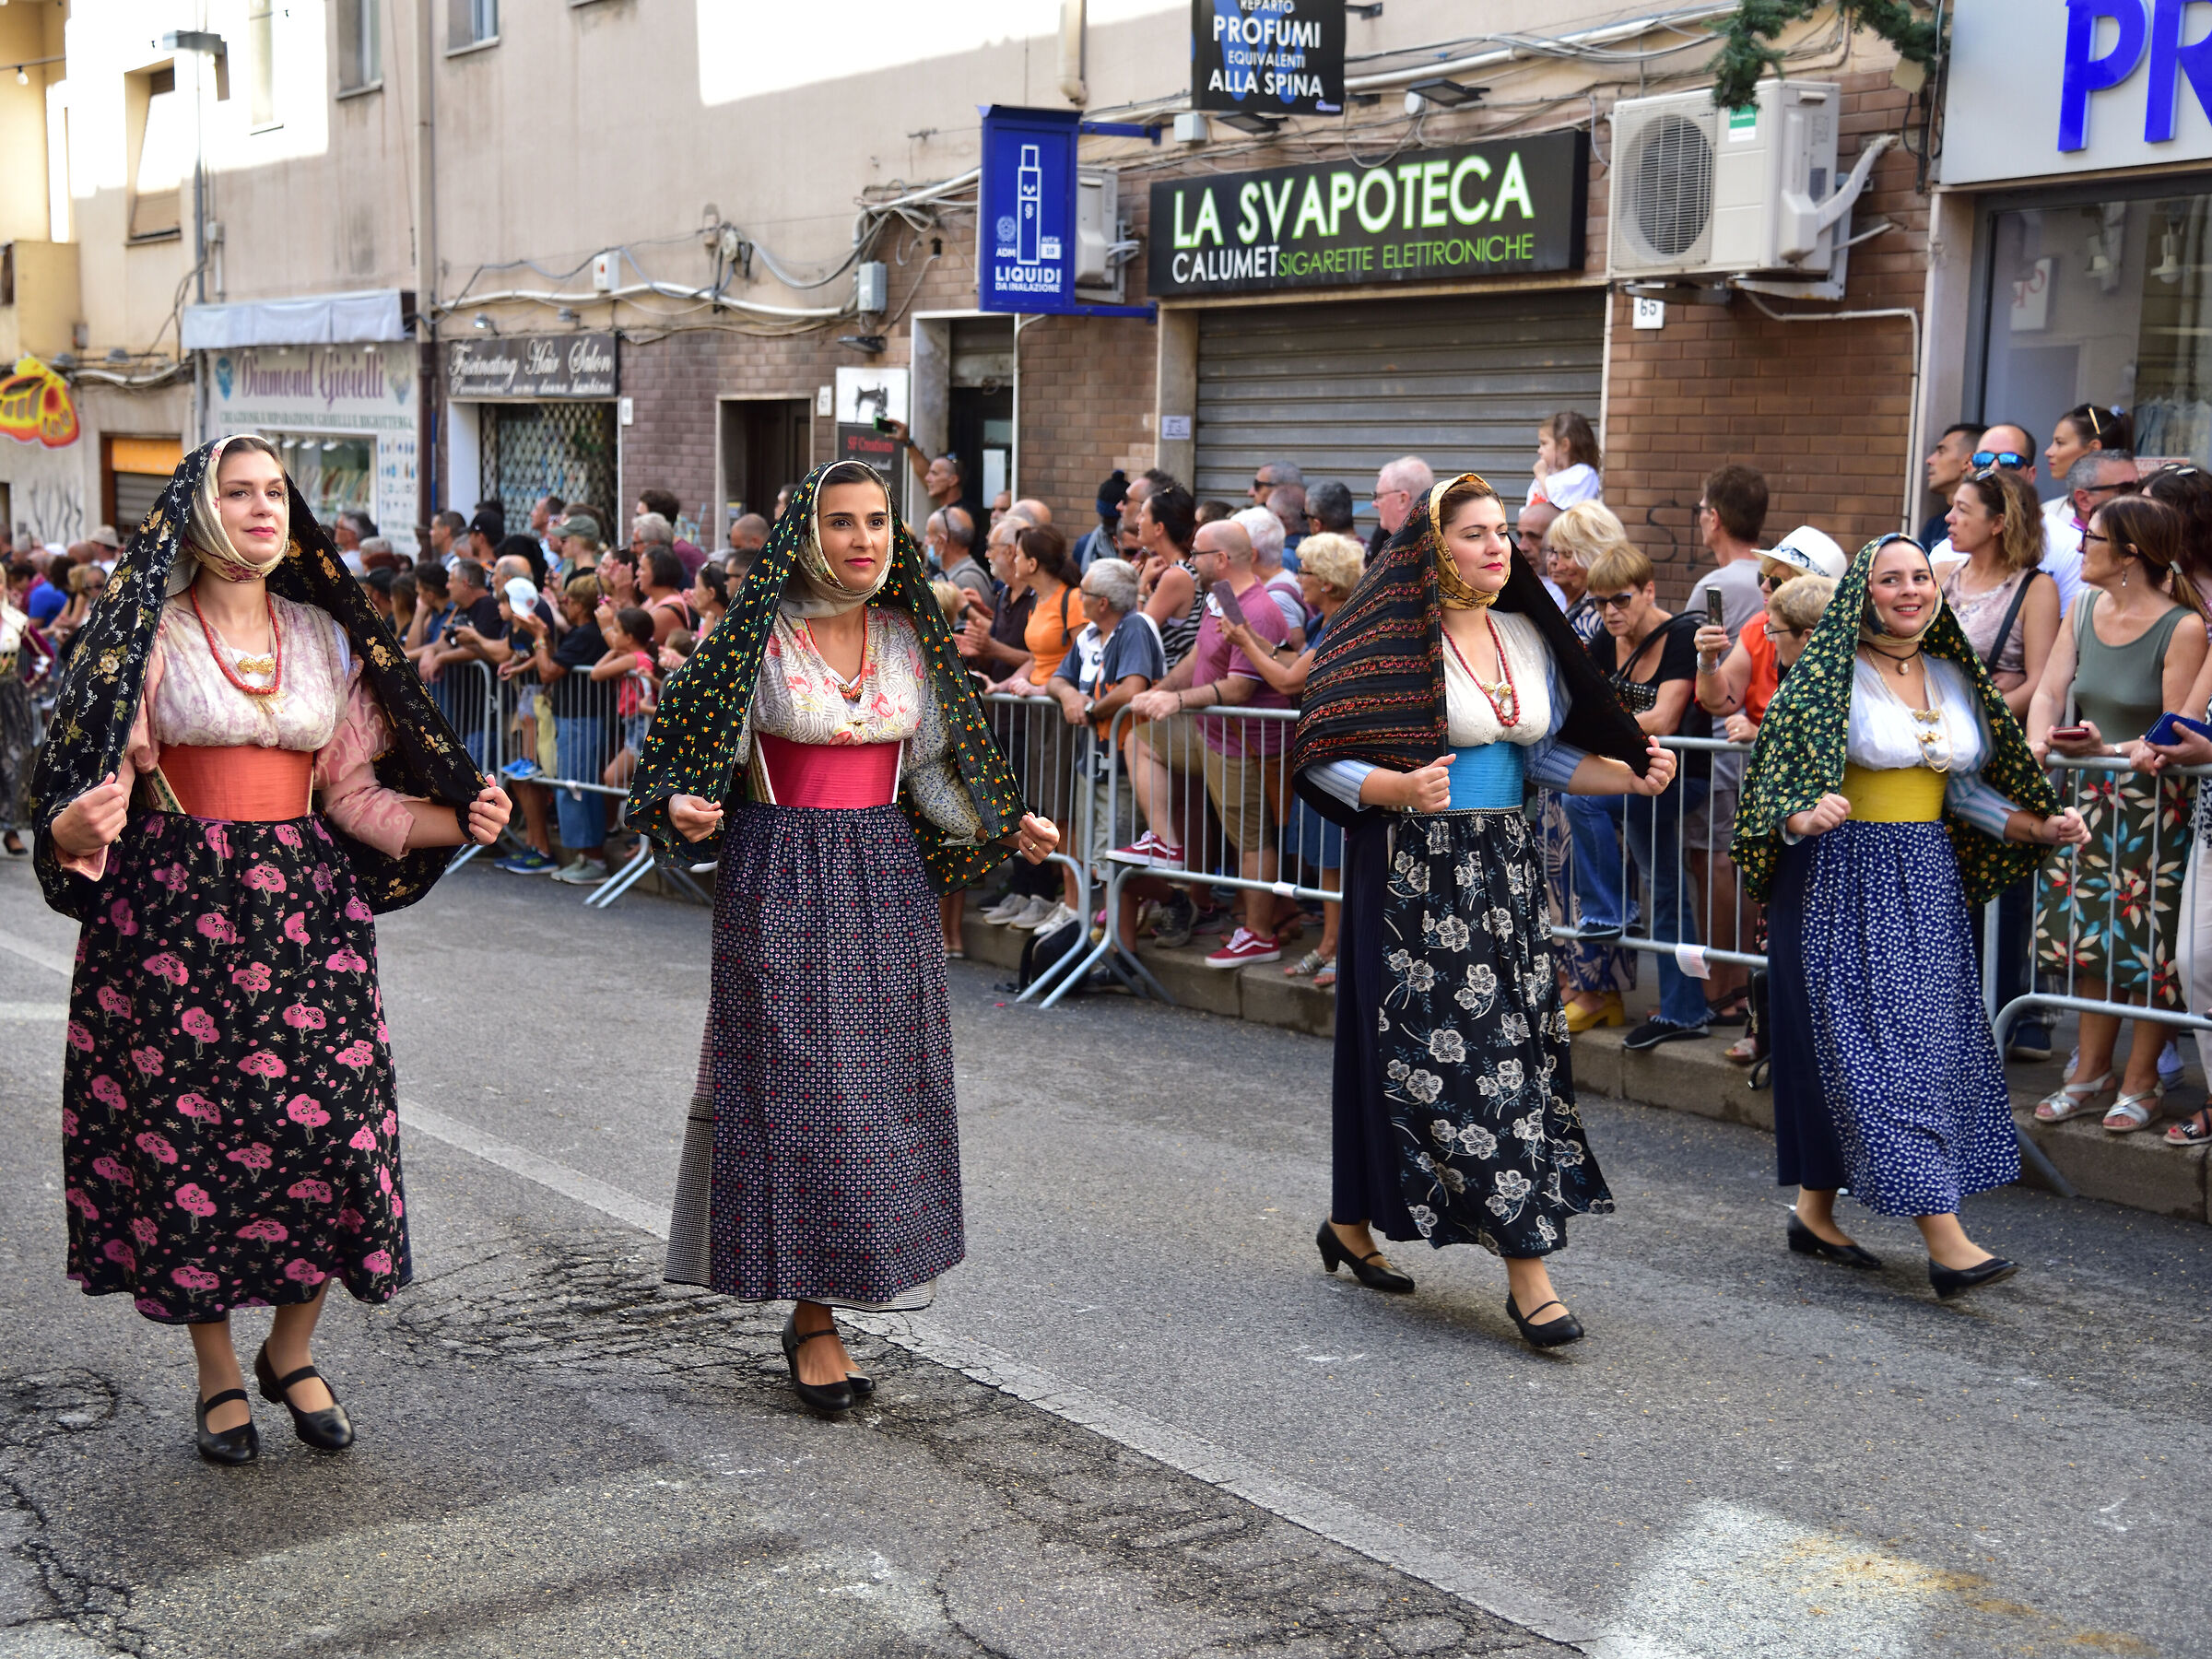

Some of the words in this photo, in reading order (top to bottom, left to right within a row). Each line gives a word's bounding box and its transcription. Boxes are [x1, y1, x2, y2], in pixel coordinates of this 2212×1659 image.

[1240, 0, 1295, 14] REPARTO
[1213, 15, 1321, 49] PROFUMI
[1228, 50, 1306, 68] EQUIVALENTI
[1208, 68, 1259, 94] ALLA
[1264, 71, 1324, 98] SPINA
[1173, 187, 1224, 250] LA
[1236, 151, 1535, 245] SVAPOTECA
[1172, 244, 1280, 284] CALUMET
[1278, 246, 1373, 277] SIGARETTE
[1382, 233, 1535, 269] ELETTRONICHE
[995, 265, 1062, 284] LIQUIDI
[995, 281, 1007, 291] DA
[1008, 282, 1062, 293] INALAZIONE
[230, 351, 313, 398] Diamond
[319, 349, 384, 411] Gioielli
